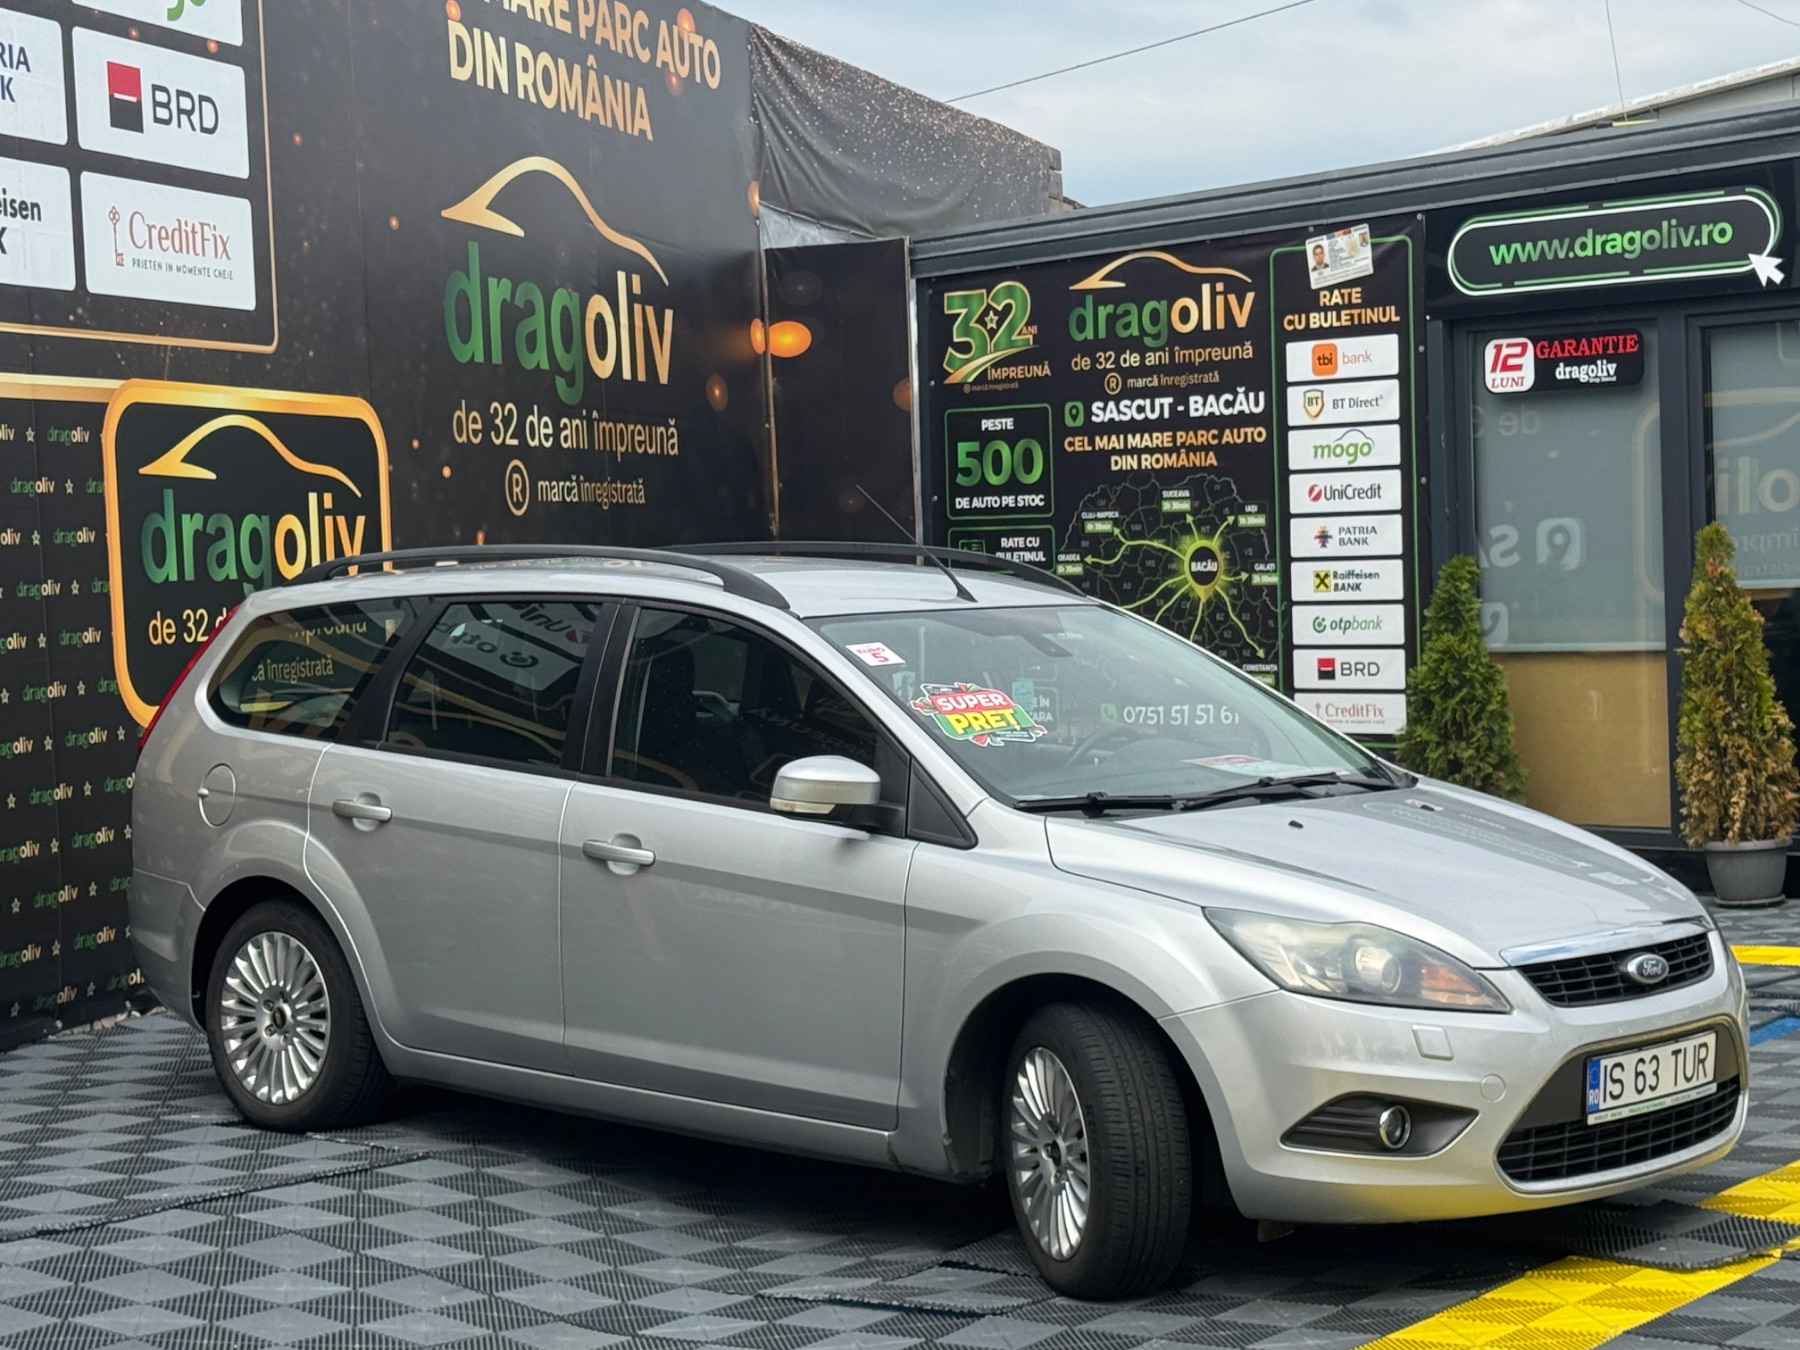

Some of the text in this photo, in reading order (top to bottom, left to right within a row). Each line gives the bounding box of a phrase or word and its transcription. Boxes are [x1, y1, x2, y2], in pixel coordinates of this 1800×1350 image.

[578, 0, 651, 63] PARC
[656, 20, 721, 90] AUTO
[447, 19, 653, 142] DIN ROMÂNIA
[151, 83, 219, 135] BRD
[0, 187, 42, 222] isen
[128, 210, 231, 261] CreditFix
[1489, 218, 1733, 265] www.dragoliv.ro
[132, 258, 162, 270] PRIETEN
[176, 264, 211, 278] MOMENTE
[213, 268, 233, 280] CHEIE
[1319, 287, 1362, 307] RATE
[443, 240, 674, 405] dragoliv
[1068, 283, 1255, 348] dragoliv
[1283, 306, 1400, 331] CU BULETINUL
[943, 281, 1038, 373] 32 ANI
[1071, 341, 1253, 371] de 32 de ani împreună
[1536, 334, 1639, 358] GARANTIE
[1317, 350, 1372, 366] tbi bank
[1490, 342, 1528, 373] 12
[987, 361, 1052, 380] ÎMPREUNĂ
[1126, 375, 1158, 389] marcă
[1160, 371, 1220, 389] înregistrată
[1555, 359, 1617, 383] dragoliv
[1491, 376, 1525, 388] LUNI
[1091, 398, 1173, 423] SASCUT
[1189, 386, 1265, 418] BACĂU
[1307, 396, 1320, 407] BT
[1332, 398, 1346, 409] BT
[453, 399, 679, 462] de 32 de ani împreună
[981, 418, 1014, 431] PESTE
[47, 426, 90, 446] dragoliv
[1064, 426, 1267, 453] CEL MAI MARE PARC AUTO
[956, 438, 1043, 487] 500
[1111, 448, 1217, 471] DIN ROMÂNIA
[1312, 441, 1372, 466] mogo
[10, 476, 104, 497] dragoliv dra
[537, 475, 579, 503] marcă
[580, 475, 646, 510] înregistrată
[1162, 490, 1190, 498] SUCEAVA
[1323, 483, 1382, 501] UniCredit
[955, 494, 1045, 509] DE AUTO PE STOC
[1081, 511, 1119, 519] CLUJ-NAPOCA
[53, 526, 96, 547] dragoliv
[1338, 526, 1377, 536] PATRIA
[1338, 537, 1369, 547] BANK
[141, 488, 365, 597] dragoliv
[1001, 537, 1040, 548] RATE CU
[1191, 560, 1217, 572] BACĂU
[1333, 570, 1380, 580] Raiffeisen
[16, 579, 61, 600] dragoliv
[1333, 583, 1362, 592] BANK
[149, 611, 176, 645] de
[183, 608, 209, 643] 32
[1330, 616, 1383, 635] otpbank
[58, 626, 101, 648] dragoliv
[871, 652, 890, 662] 5
[267, 654, 334, 684] înregistrată
[1340, 661, 1380, 677] BRD
[22, 681, 67, 703] dragoliv
[937, 693, 1007, 711] SUPER
[945, 708, 1020, 734] PREȚ
[1123, 706, 1164, 725] 0751
[1170, 704, 1189, 726] 51
[1195, 704, 1214, 725] 51
[1325, 702, 1384, 719] CreditFix
[65, 727, 108, 749] dragoliv
[28, 782, 74, 806] dragoliv
[71, 826, 115, 849] dragoliv
[33, 884, 78, 908] dragoliv
[72, 925, 117, 951] dragoliv
[1643, 960, 1662, 976] Ford
[32, 985, 77, 1010] dragoliv
[1603, 1042, 1709, 1103] IS 63 TUR
[1588, 1090, 1599, 1105] RO
